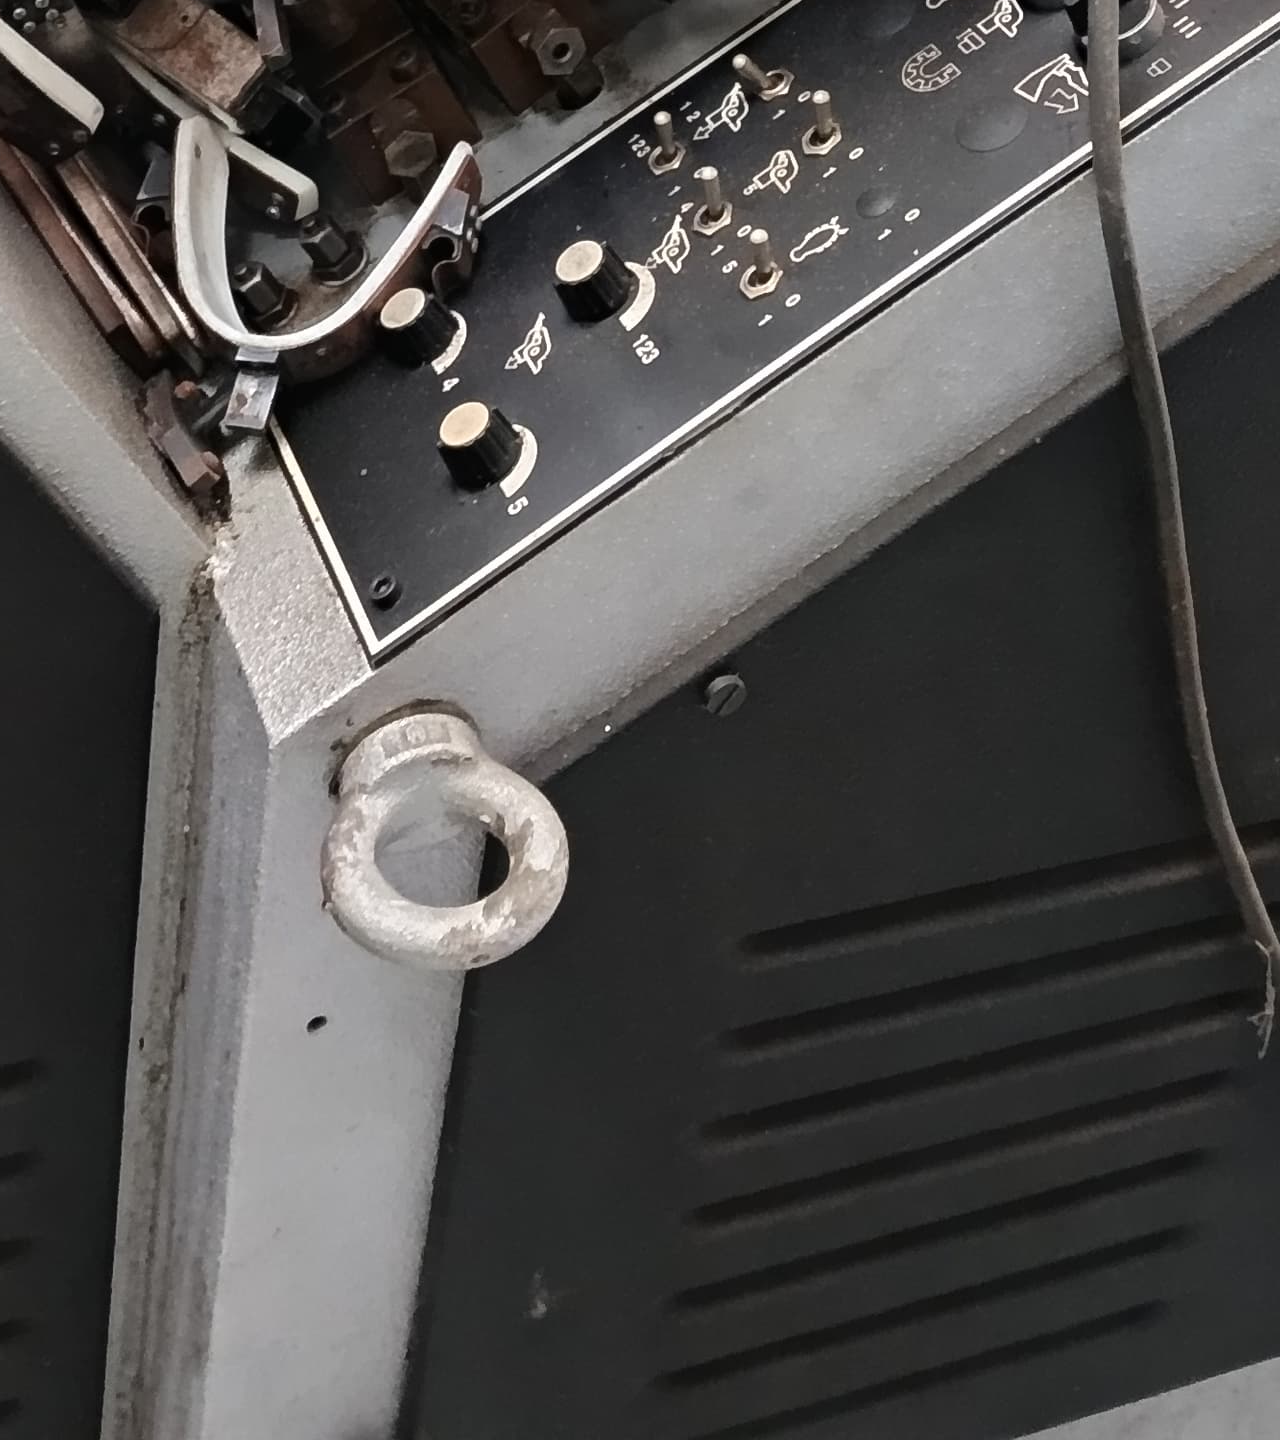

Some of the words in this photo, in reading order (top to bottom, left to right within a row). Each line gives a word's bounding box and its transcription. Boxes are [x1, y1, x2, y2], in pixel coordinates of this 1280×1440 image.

[627, 133, 652, 158] 123
[632, 333, 660, 365] 123
[507, 496, 529, 516] 5
